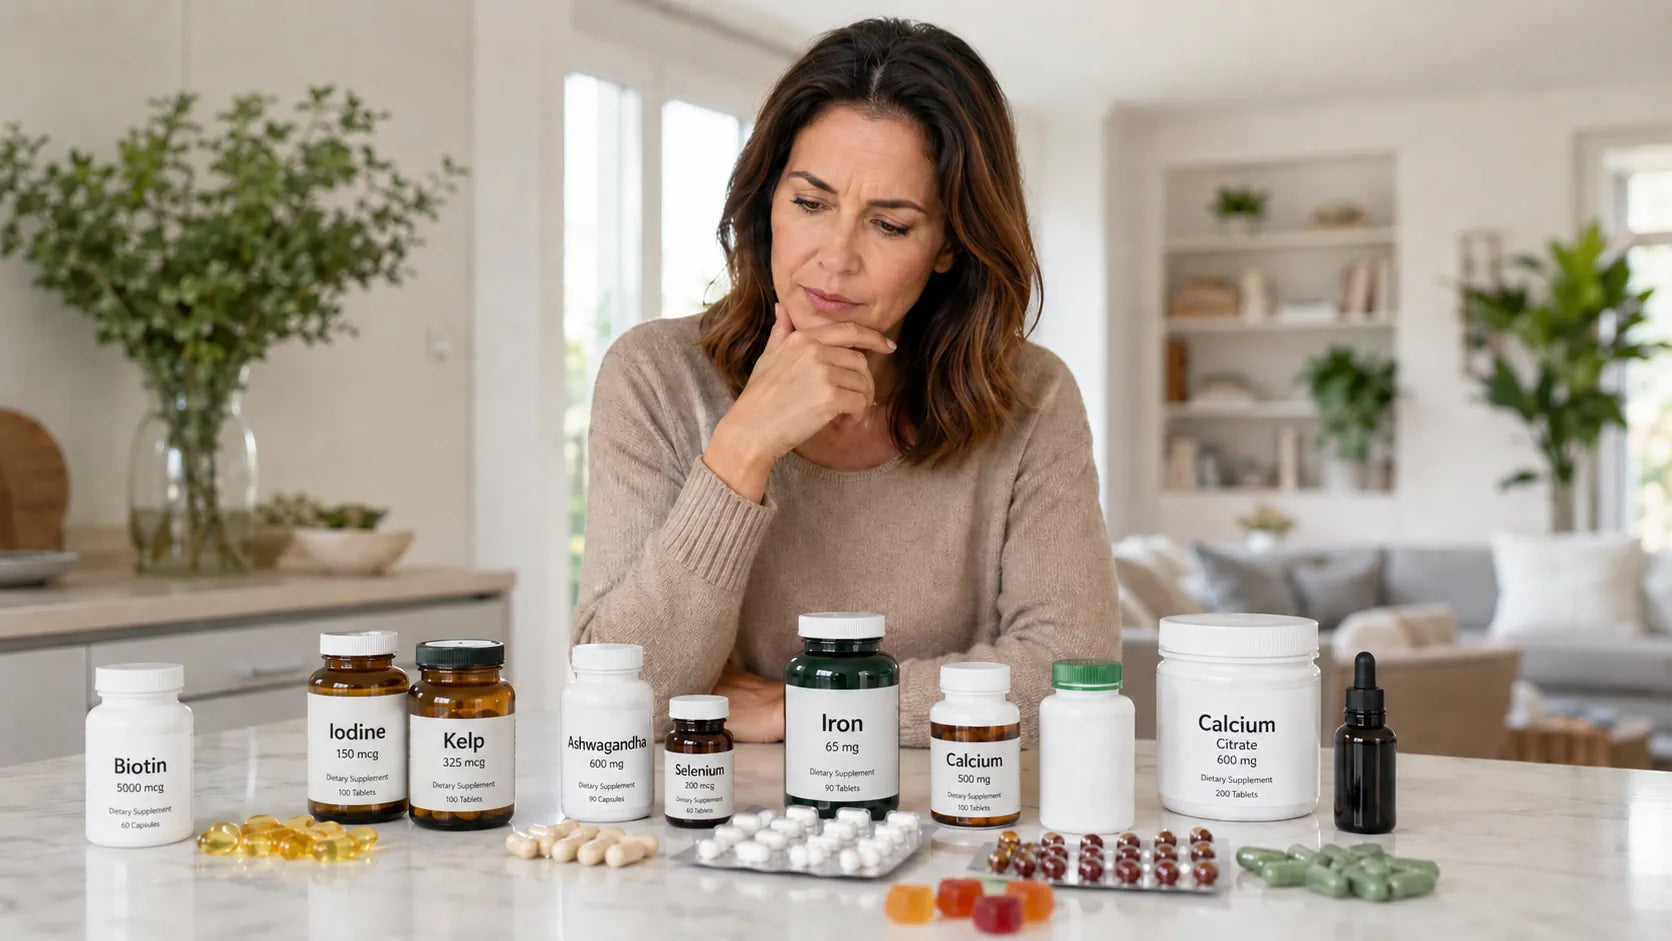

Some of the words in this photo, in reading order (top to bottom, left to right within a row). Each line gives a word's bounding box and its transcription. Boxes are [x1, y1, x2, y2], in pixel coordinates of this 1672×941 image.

[822, 713, 863, 732] Iron
[1199, 714, 1275, 733] Calcium
[330, 723, 386, 740] Iodine
[444, 732, 484, 753] Kelp
[568, 735, 647, 754] Ashwagandha
[826, 741, 839, 752] 65
[842, 743, 859, 755] mg
[1216, 738, 1257, 750] Citrate
[337, 749, 354, 759] 150
[357, 750, 378, 761] mcg
[946, 752, 1002, 768] Calcium
[114, 757, 166, 774] Biotin
[443, 757, 462, 767] 325
[465, 758, 485, 769] mcg
[590, 759, 607, 769] 600
[610, 760, 623, 770] mg
[1217, 755, 1237, 766] 600
[1240, 757, 1257, 768] mg
[675, 764, 724, 776] Selenium
[810, 768, 833, 777] Dietary
[835, 768, 875, 777] Supplement
[326, 774, 348, 783] Dietary
[350, 774, 389, 783] Supplement
[958, 774, 974, 783] 500
[977, 775, 990, 785] mg
[1201, 774, 1226, 784] Dietary
[1228, 775, 1273, 785] Supplement
[117, 783, 141, 793] 5000
[144, 784, 164, 794] mcg
[433, 781, 455, 790] Dietary
[457, 781, 496, 790] Supplement
[579, 782, 598, 791] Dietary
[600, 782, 636, 791] Supplement
[700, 782, 714, 790] mcg
[825, 784, 834, 792] 90
[835, 784, 860, 792] Tablets
[948, 792, 966, 800] Dietary
[968, 792, 1002, 800] Supplement
[1216, 789, 1230, 798] 200
[1232, 790, 1258, 798] Tablets
[589, 796, 597, 804] 90
[598, 796, 624, 804] Capsules
[109, 806, 132, 816] Dietary
[133, 806, 172, 816] Supplement
[121, 821, 130, 829] 60
[131, 821, 160, 829] Capsules
